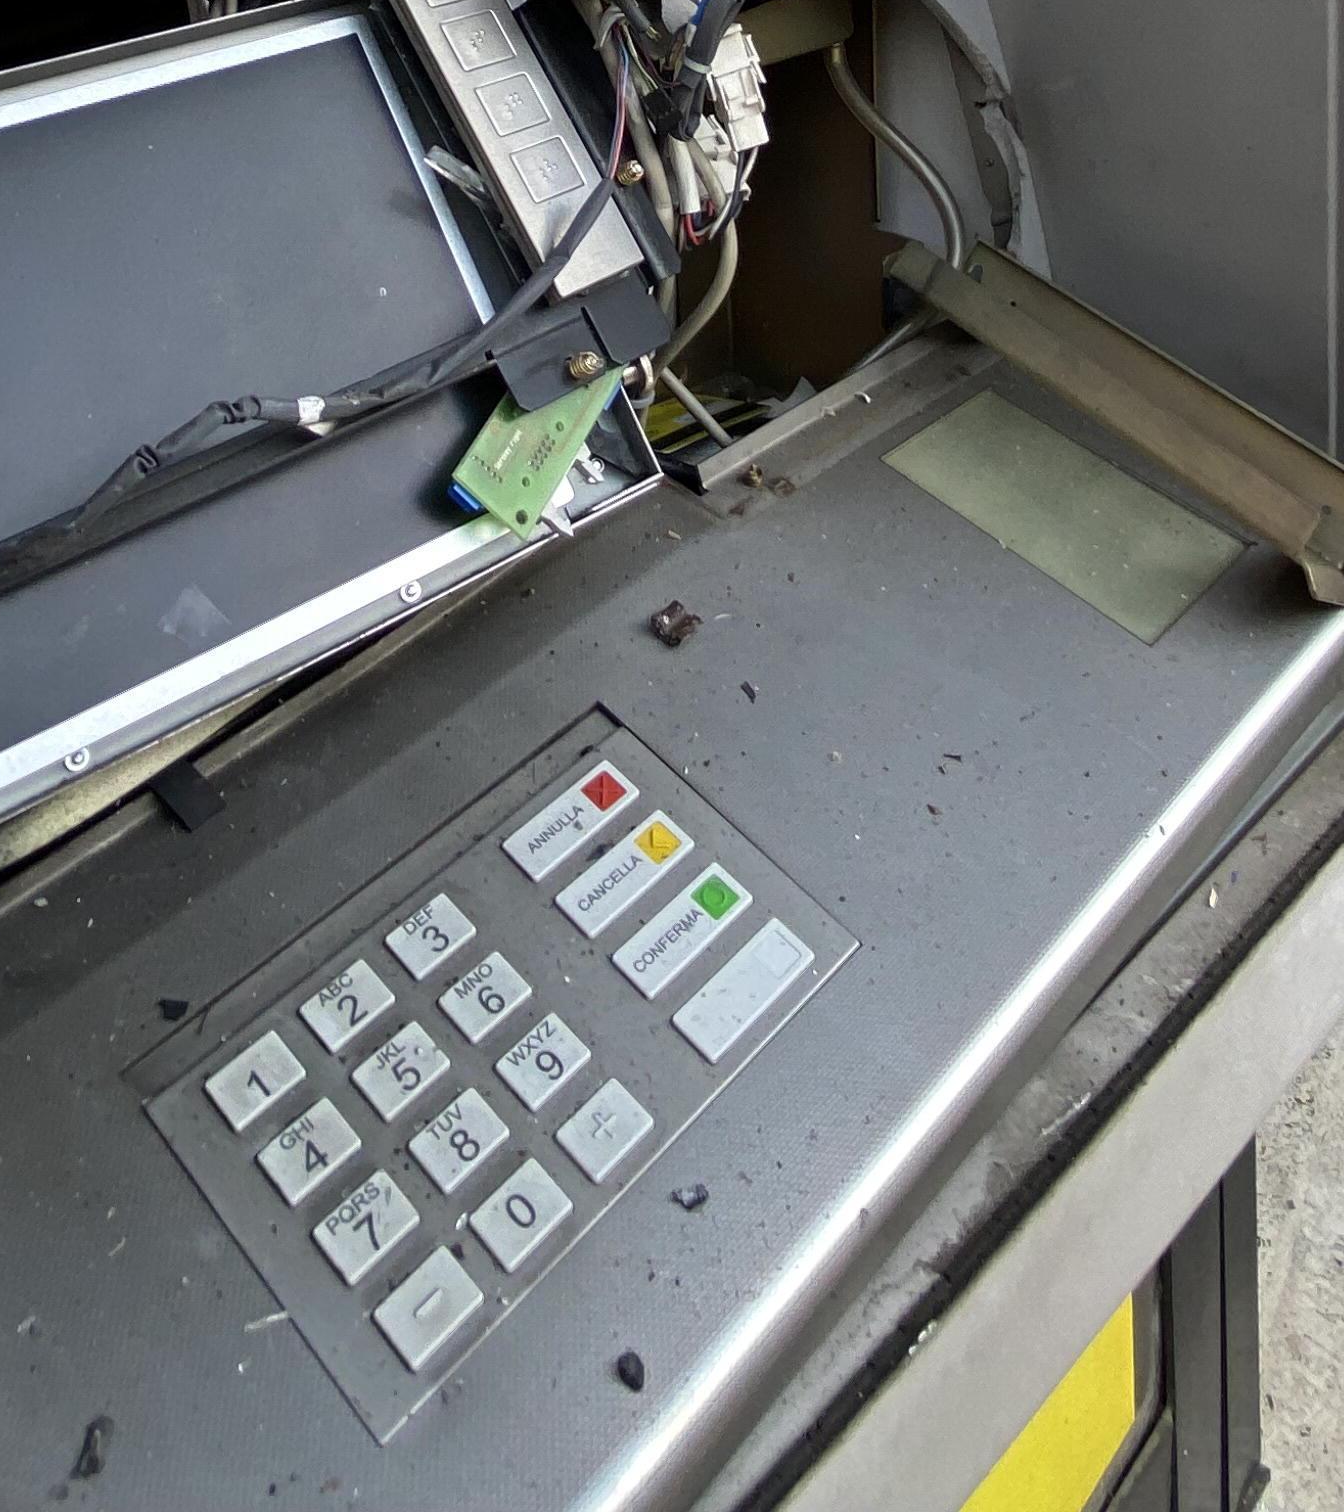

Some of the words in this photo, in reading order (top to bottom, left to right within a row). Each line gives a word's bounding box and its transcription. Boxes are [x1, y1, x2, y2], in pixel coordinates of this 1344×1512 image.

[526, 803, 584, 856] ANNULLA
[577, 854, 643, 913] CANCELLA
[402, 904, 436, 937] DEF
[421, 925, 451, 954] 3
[632, 908, 704, 974] CONFERMA
[317, 972, 355, 1008] ABC
[454, 962, 495, 1002] MNO
[336, 995, 370, 1028] 2
[477, 985, 507, 1016] 6
[374, 1039, 406, 1071] JKL
[506, 1021, 558, 1068] WXYZ
[246, 1069, 273, 1099] 1
[392, 1062, 422, 1093] 5
[534, 1051, 566, 1082] 9
[278, 1117, 316, 1152] GHI
[426, 1103, 466, 1141] TUV
[302, 1140, 330, 1176] 4
[448, 1128, 481, 1164] 8
[324, 1182, 382, 1238] PQRS
[505, 1193, 538, 1231] 0
[352, 1211, 383, 1252] 7
